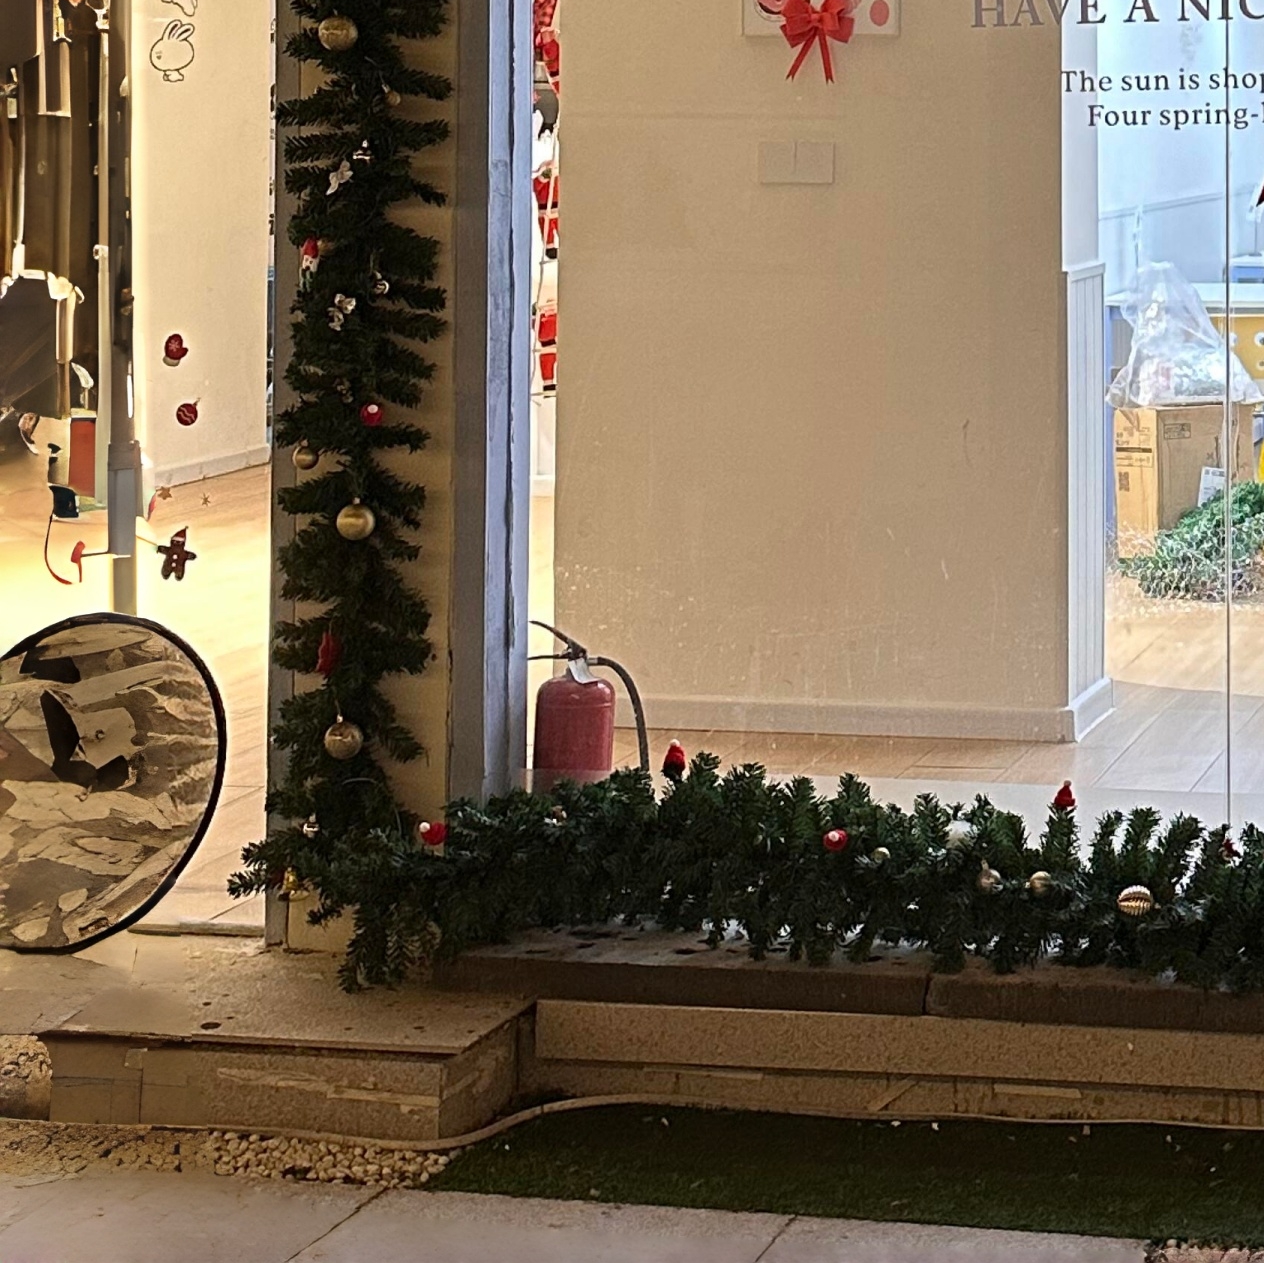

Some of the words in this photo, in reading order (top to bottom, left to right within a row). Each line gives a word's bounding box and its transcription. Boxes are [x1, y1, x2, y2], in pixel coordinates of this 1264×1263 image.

[1061, 70, 1112, 92] The
[1120, 75, 1169, 92] sun
[1179, 68, 1200, 90] is
[1088, 104, 1151, 127] Four
